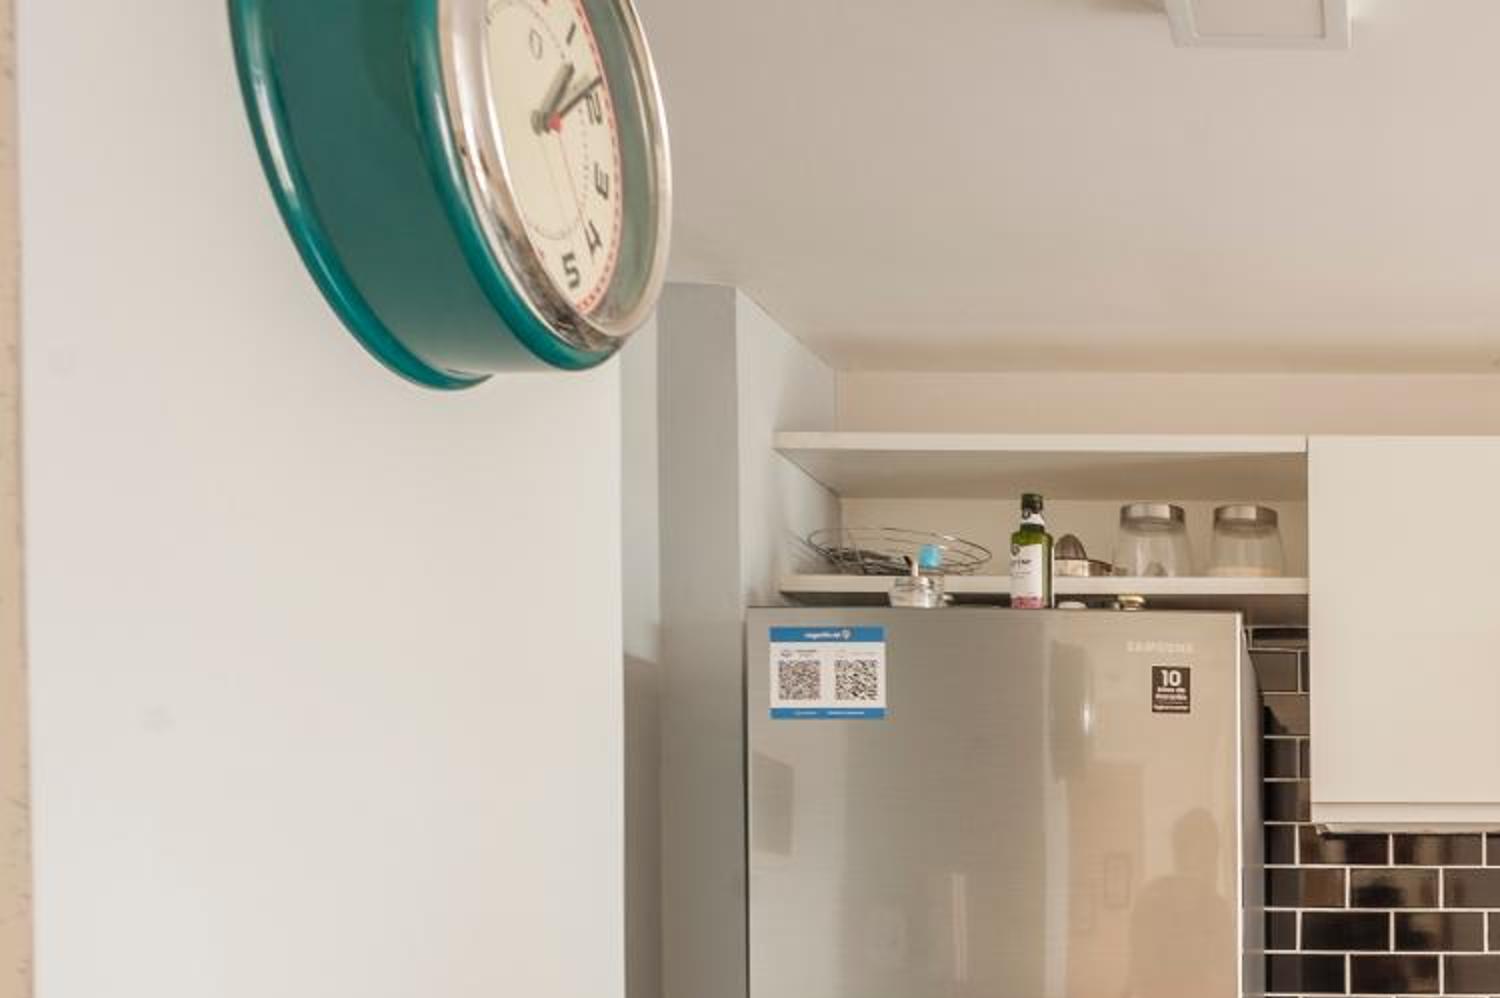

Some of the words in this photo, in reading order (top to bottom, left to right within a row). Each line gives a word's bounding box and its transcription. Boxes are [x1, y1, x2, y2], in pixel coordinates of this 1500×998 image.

[586, 92, 603, 126] 2
[594, 163, 609, 200] 3
[584, 220, 603, 257] 4
[561, 253, 581, 290] 5
[1160, 669, 1182, 687] 10
